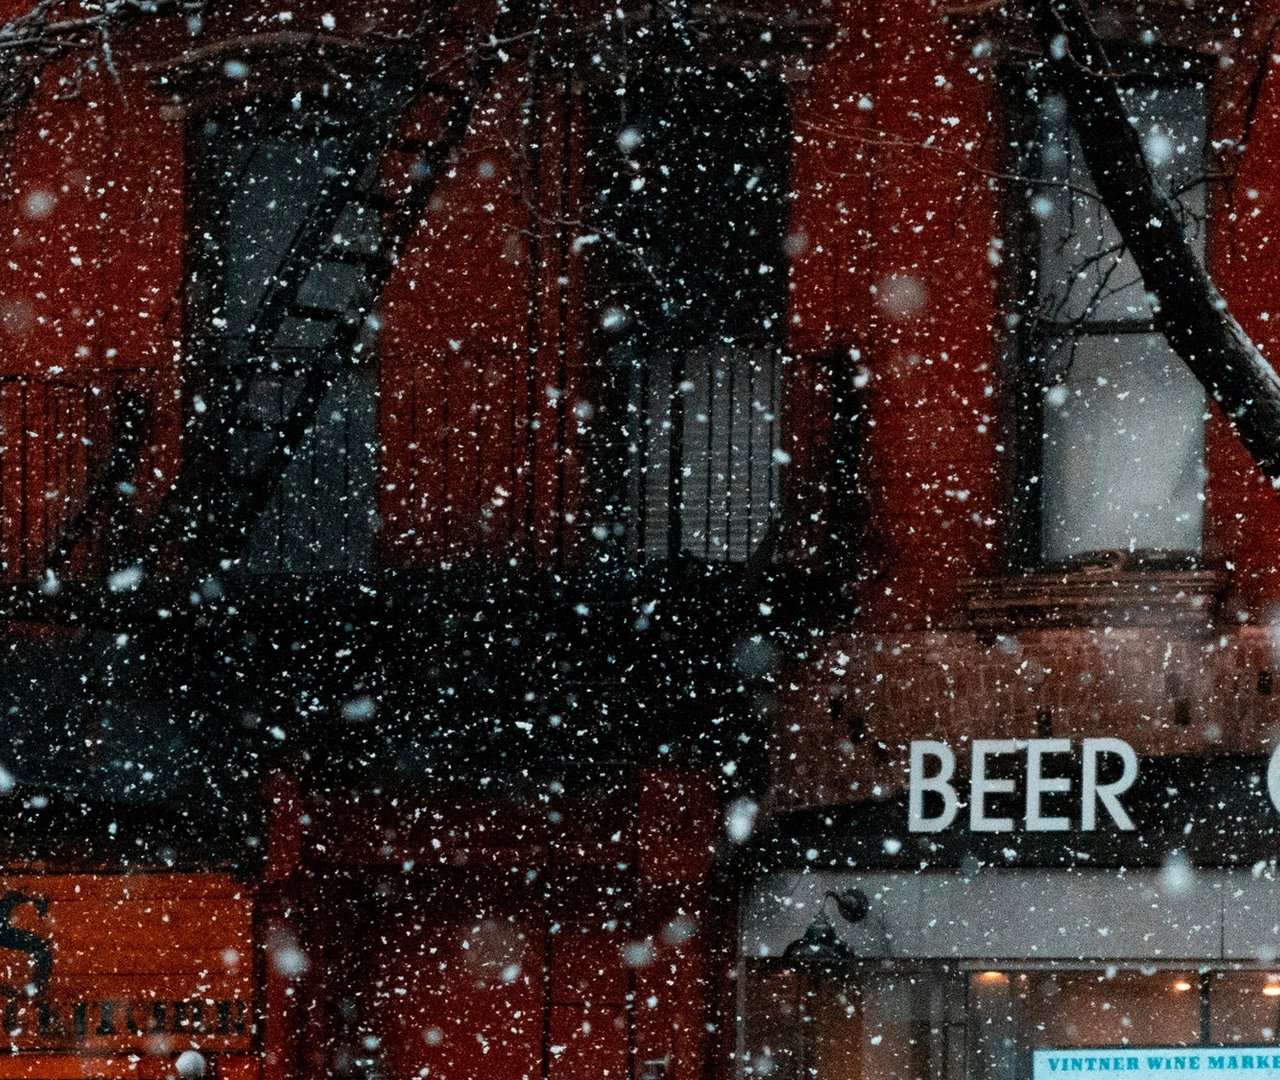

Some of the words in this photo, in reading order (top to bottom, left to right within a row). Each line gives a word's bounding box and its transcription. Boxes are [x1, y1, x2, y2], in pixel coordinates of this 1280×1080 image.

[908, 738, 1138, 832] BEER
[1048, 1057, 1139, 1071] VINTNER
[1147, 1056, 1200, 1070] WINE
